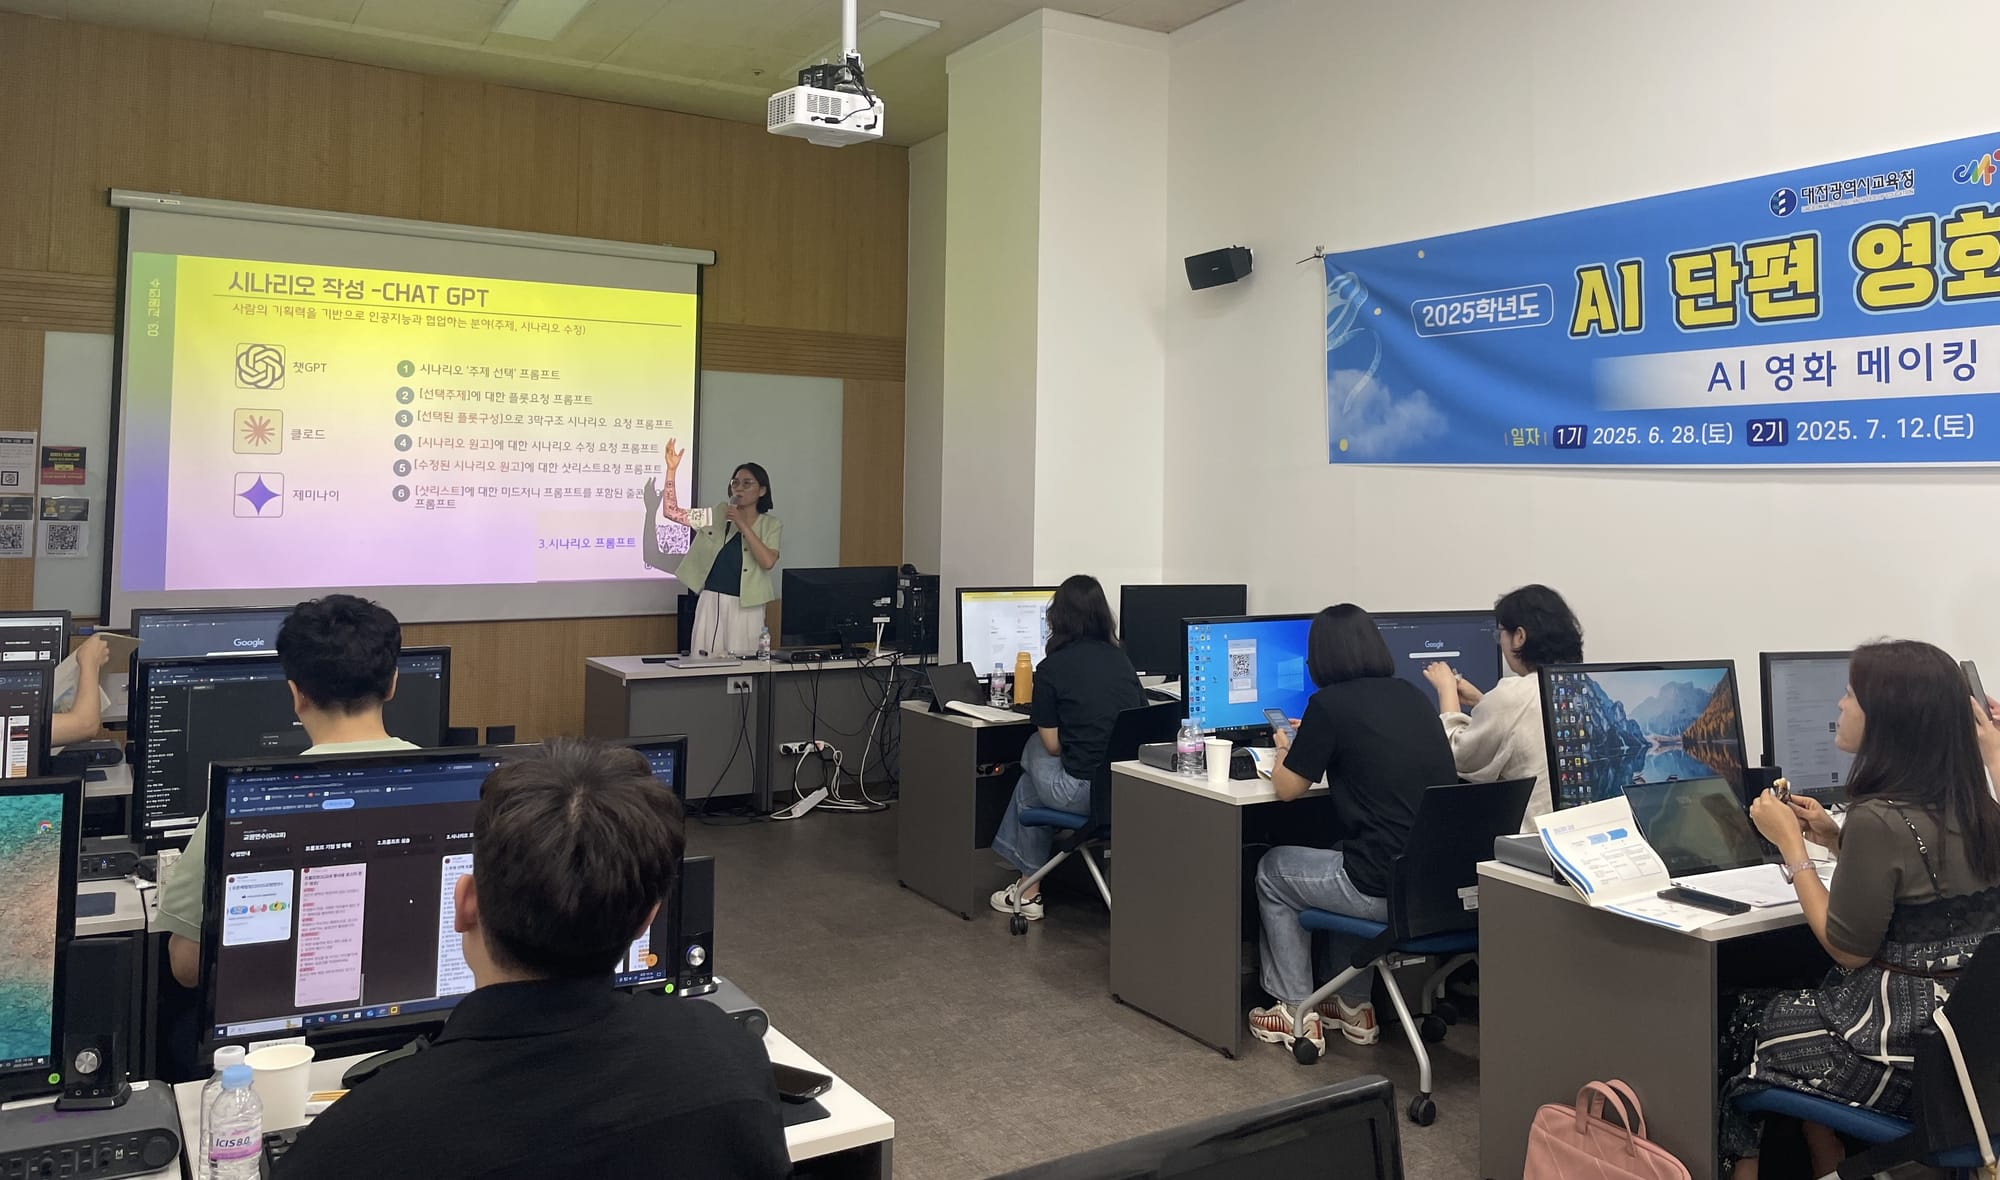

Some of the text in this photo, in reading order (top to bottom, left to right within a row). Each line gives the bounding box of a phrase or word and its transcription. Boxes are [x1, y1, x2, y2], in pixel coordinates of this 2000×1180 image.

[1801, 168, 1915, 205] 대전광역시교육청
[228, 271, 316, 297] 시나리오
[322, 277, 365, 300] 작성
[446, 286, 489, 308] GPT
[1570, 260, 1643, 337] AI
[1669, 232, 1820, 330] 단편
[1422, 291, 1540, 328] 2025학년도
[232, 303, 586, 336] 사람의 기획력을 기반으로 인공지능과 협업하는 분야(주제, 시나리오 수정)
[292, 360, 328, 374] 챗GPT
[420, 363, 464, 376] 시나리오
[519, 368, 561, 381] 프롬프트
[1707, 339, 1977, 393] AI 영화 메이킹
[419, 387, 481, 402] [선택주제]에
[485, 391, 506, 403] 대한
[508, 392, 550, 406] 플롯요청
[553, 394, 593, 406] 프롬프트
[417, 409, 454, 424] [선택된
[457, 411, 525, 425] 플롯구성]으로
[527, 414, 565, 427] 3막구조
[567, 415, 607, 428] 시나리오
[613, 418, 633, 430] 요청
[635, 419, 673, 430] 프롬프트
[290, 428, 327, 441] 클로드
[1510, 413, 1975, 447] 일자 1기 2025. 6. 28.(토) 2기 2025. 7. 12.(토)
[418, 436, 465, 449] [시나리오
[468, 438, 505, 451] 원고]에
[507, 439, 528, 452] 대한
[531, 440, 573, 453] 시나리오
[575, 442, 595, 454] 수정
[598, 443, 618, 454] 요청
[620, 443, 660, 455] 프롬프트
[414, 458, 451, 472] [수정된
[454, 460, 497, 472] 시나리오
[499, 460, 535, 473] 원고]에
[538, 462, 558, 474] 대한
[623, 463, 663, 475] 프롬프트
[292, 489, 340, 502] 제미나이
[478, 486, 498, 498] 대한
[501, 486, 541, 499] 미드저니
[543, 487, 592, 499] 프롬프트를
[595, 487, 623, 499] 포함된
[414, 498, 457, 511] 프롬프트
[538, 537, 637, 550] 3.시나리오 프롬프트
[234, 637, 265, 648] Google
[1424, 639, 1444, 649] Google
